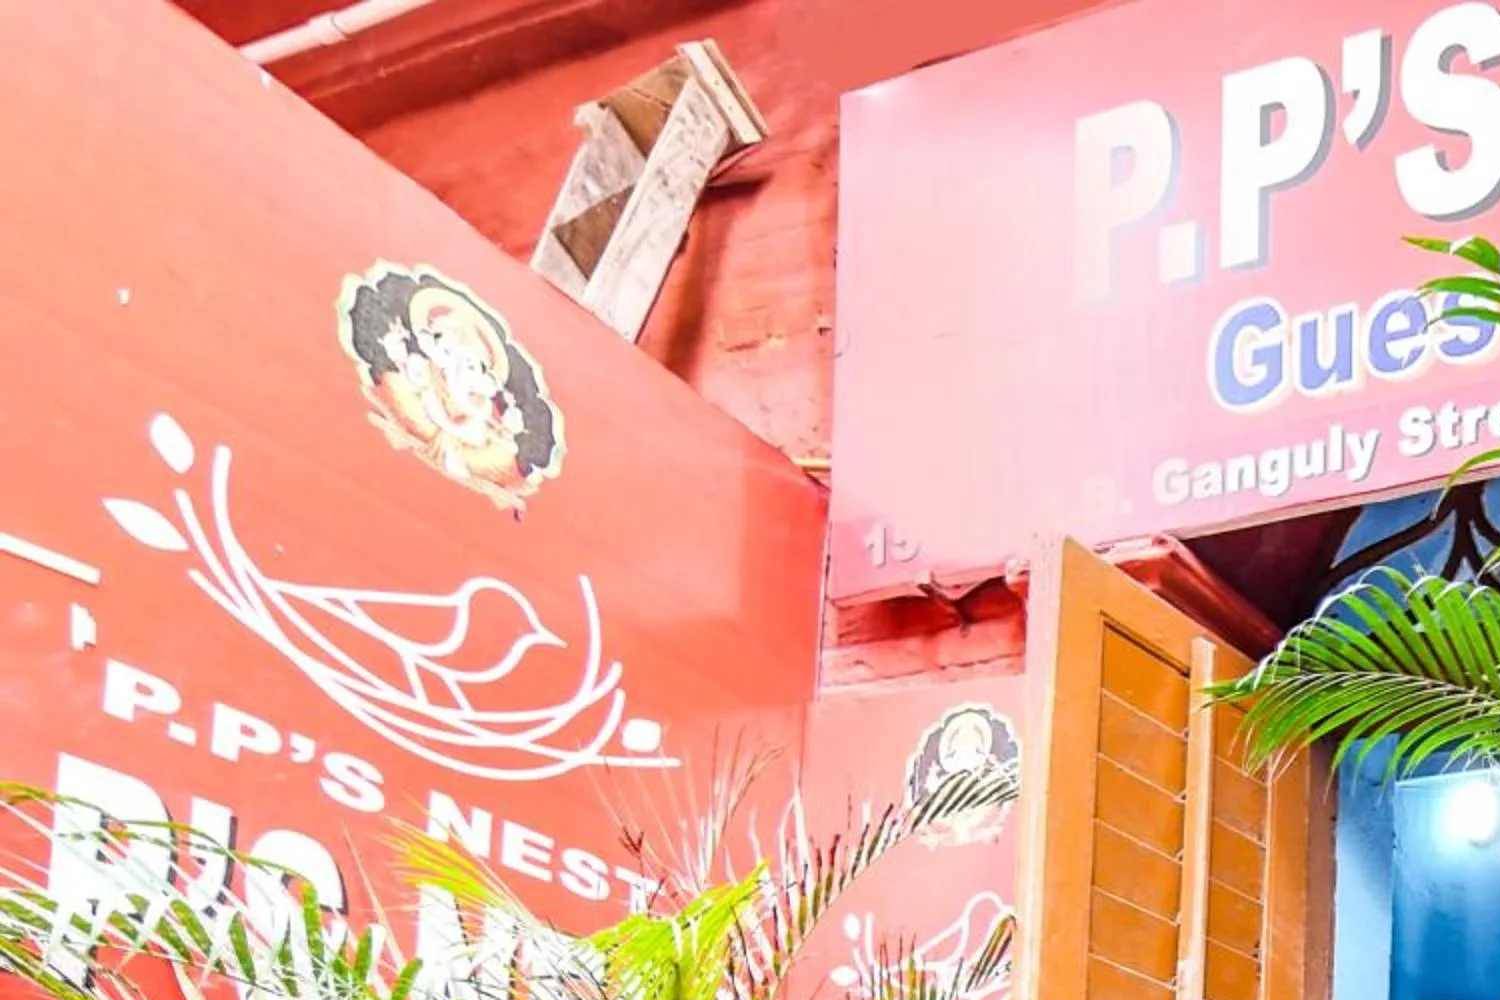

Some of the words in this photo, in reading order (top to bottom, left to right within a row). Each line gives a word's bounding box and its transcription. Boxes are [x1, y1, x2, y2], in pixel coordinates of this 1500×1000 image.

[1152, 424, 1380, 505] Ganguly
[103, 657, 386, 813] P.P'S
[427, 788, 668, 917] NEST
